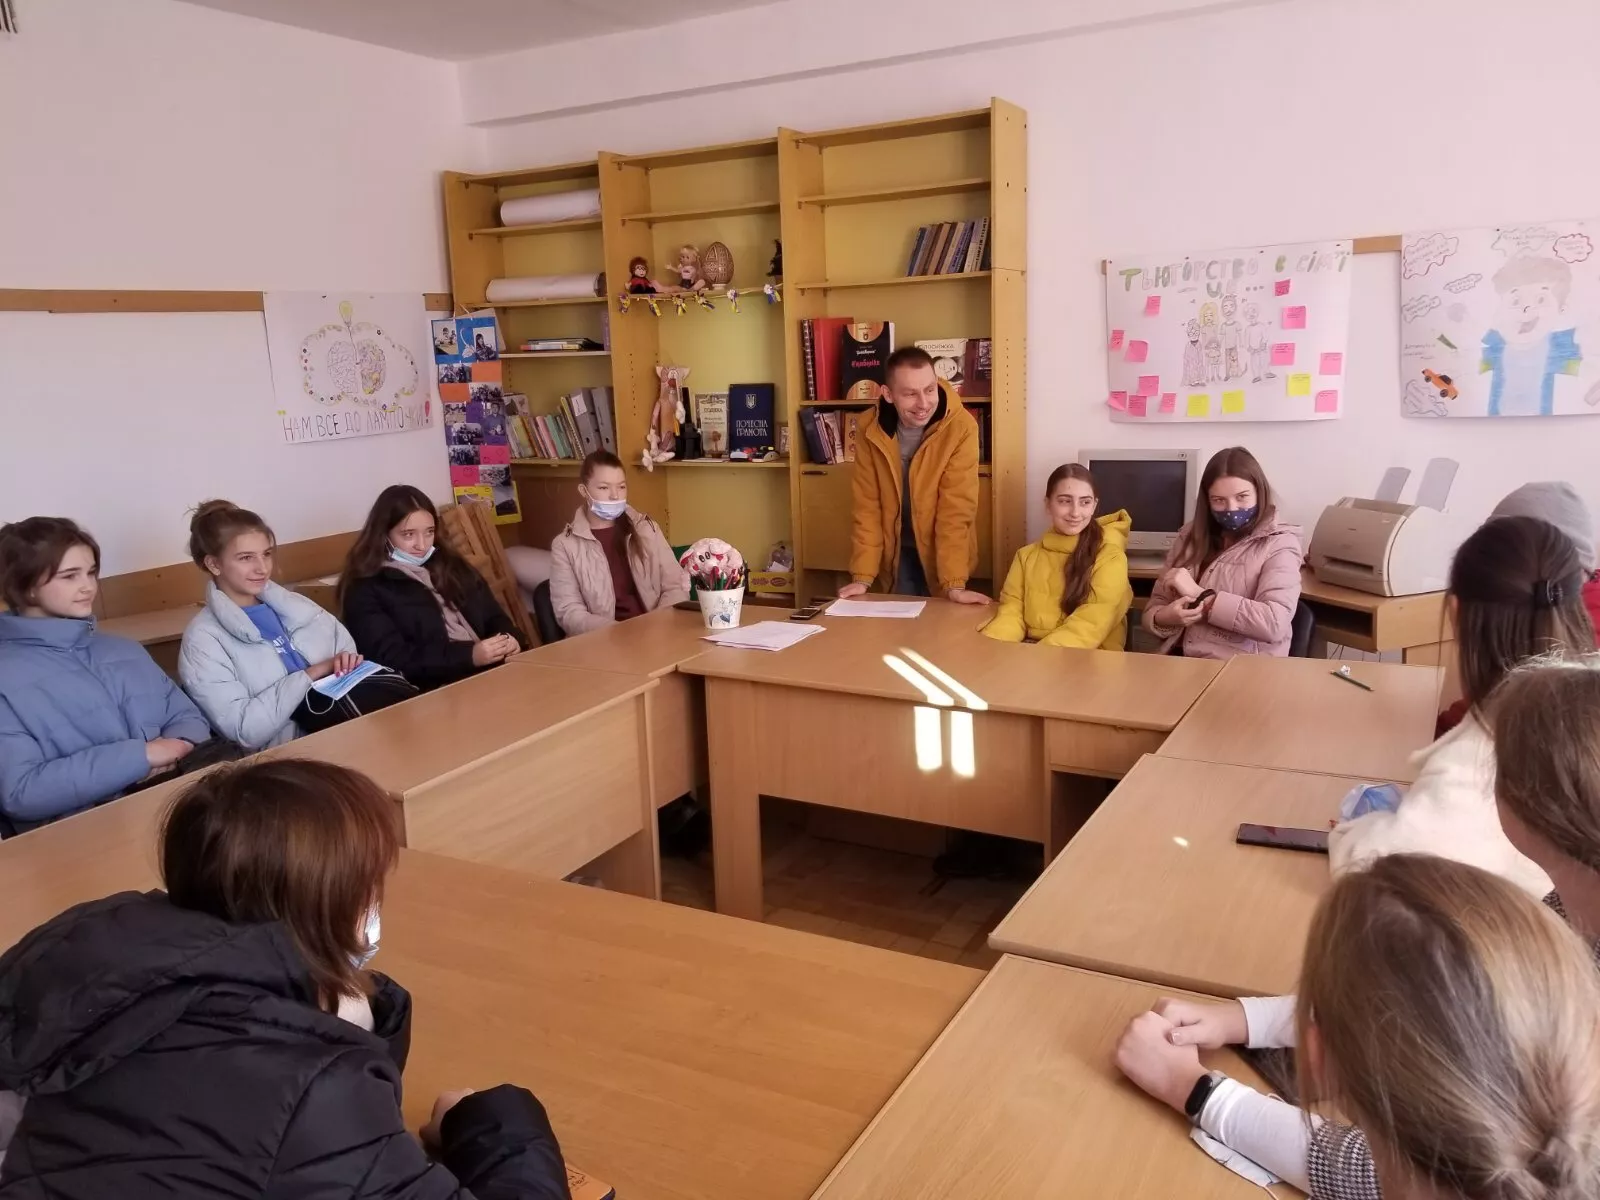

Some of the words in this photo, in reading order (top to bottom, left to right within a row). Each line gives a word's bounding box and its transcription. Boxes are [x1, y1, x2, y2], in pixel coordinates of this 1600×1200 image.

[1118, 257, 1259, 291] ТЬЮТОРСТВО
[316, 413, 341, 437] ВСЕ
[345, 410, 361, 433] ДО
[735, 419, 768, 428] ПОЧЕСНА
[736, 428, 768, 437] ГРАМОТА
